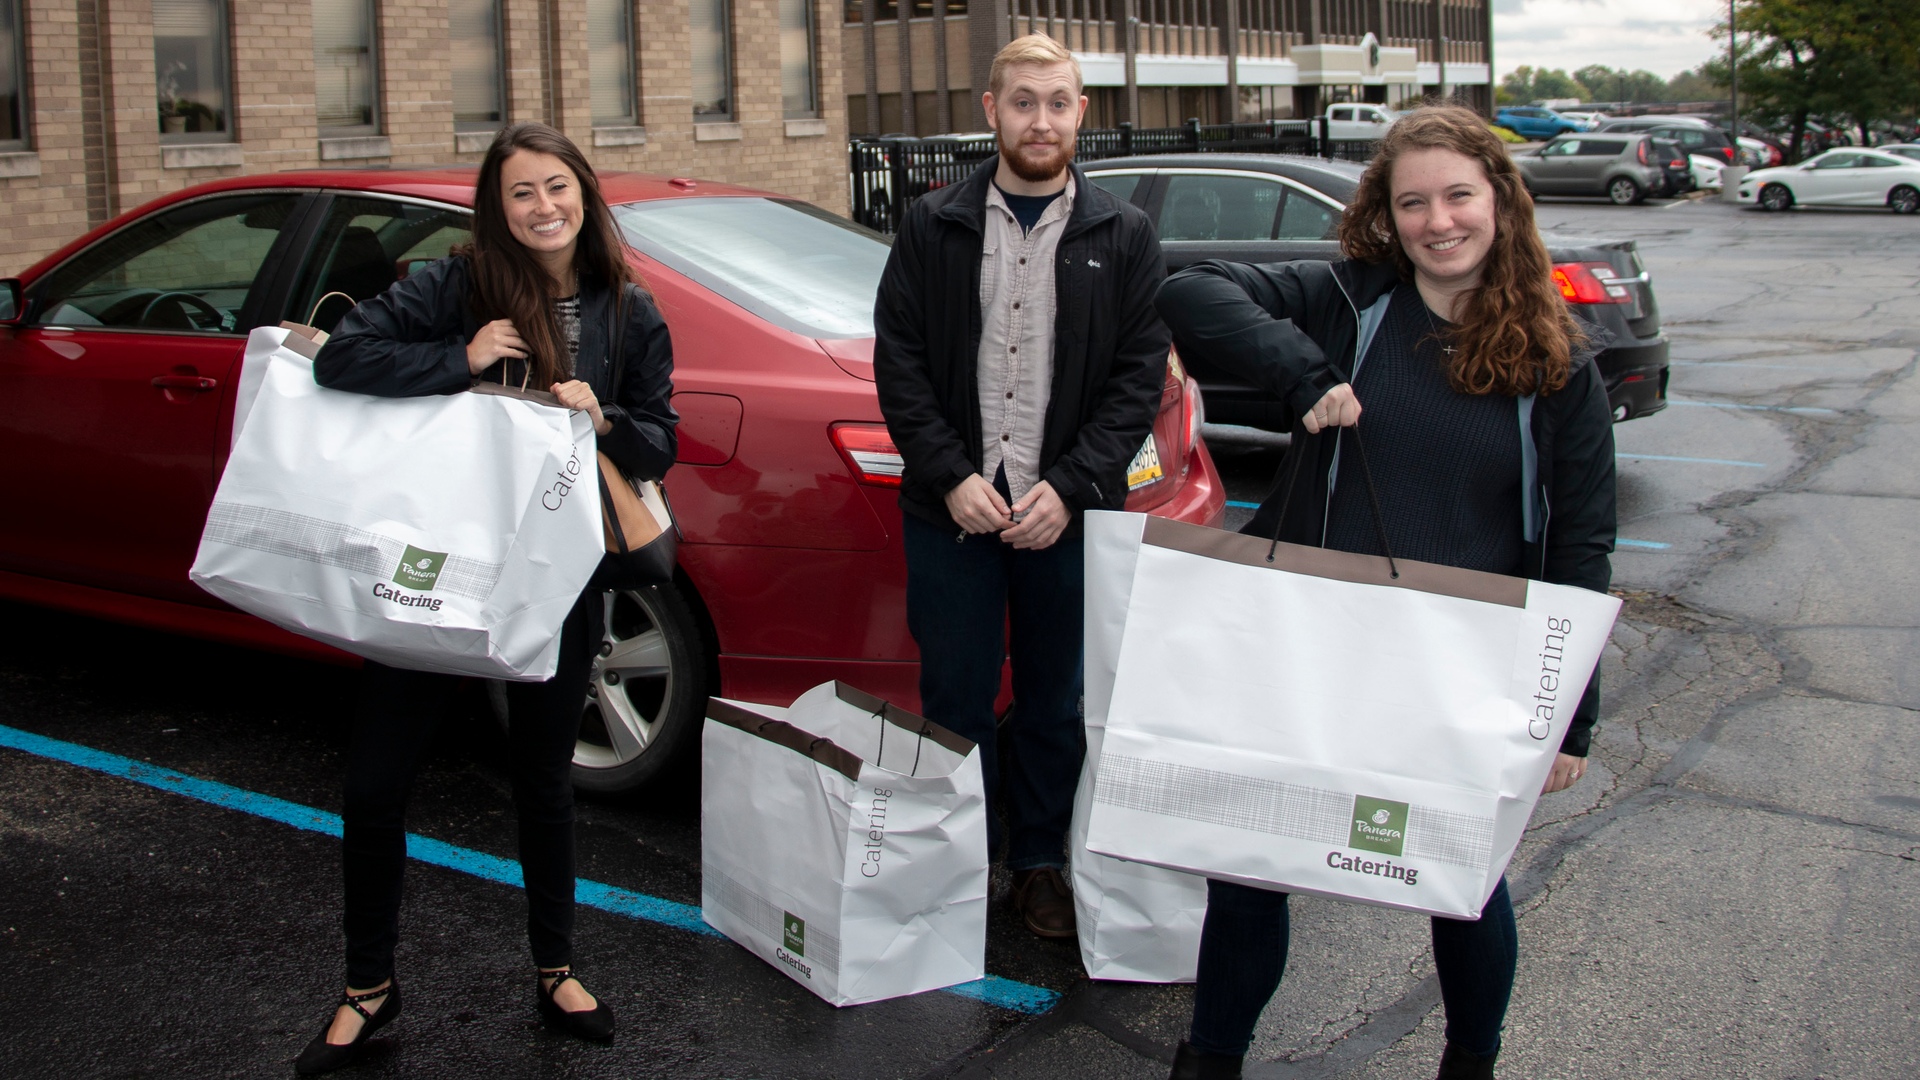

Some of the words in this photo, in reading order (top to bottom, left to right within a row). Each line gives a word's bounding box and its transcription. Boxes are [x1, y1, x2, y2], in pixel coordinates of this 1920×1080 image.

[402, 562, 437, 578] Panera
[372, 582, 443, 611] Catering
[1528, 615, 1572, 741] Catering
[861, 787, 893, 878] Catering
[1355, 819, 1401, 839] Panera
[1326, 851, 1418, 886] Catering
[776, 947, 812, 979] Catering
